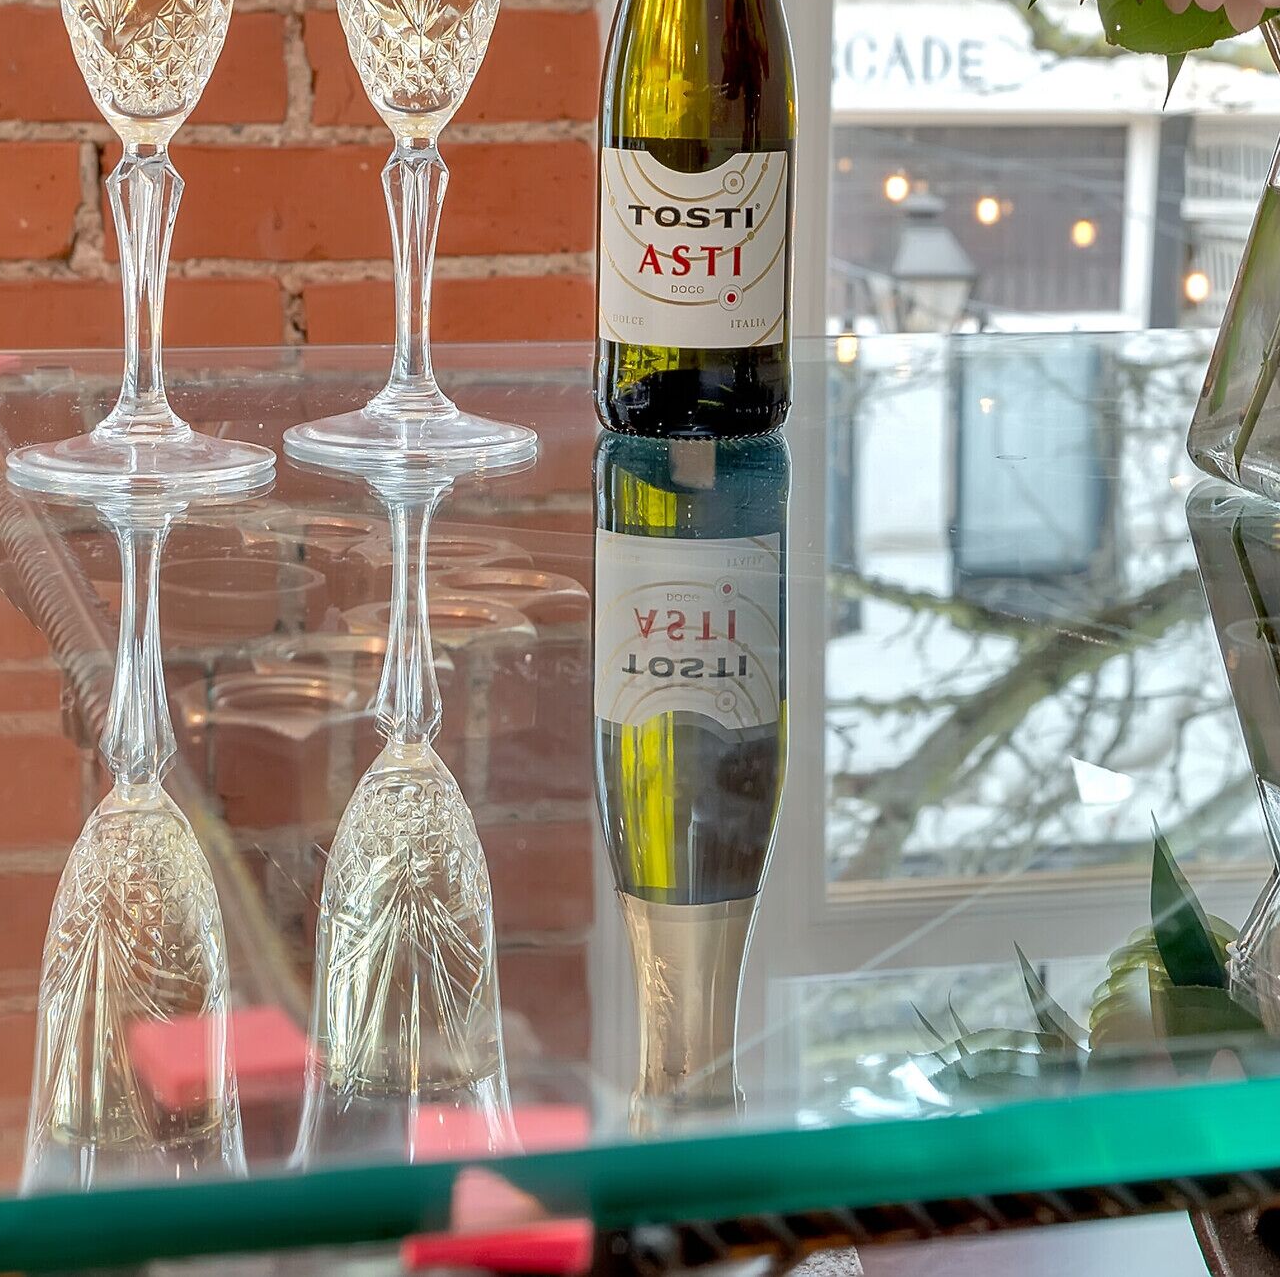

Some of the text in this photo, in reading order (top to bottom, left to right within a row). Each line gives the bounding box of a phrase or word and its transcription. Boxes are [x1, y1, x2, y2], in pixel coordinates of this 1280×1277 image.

[832, 31, 986, 86] CADE
[638, 243, 742, 276] ASTI
[671, 284, 705, 294] DOCG
[612, 313, 645, 326] DOLCE
[730, 317, 766, 328] ITALIA
